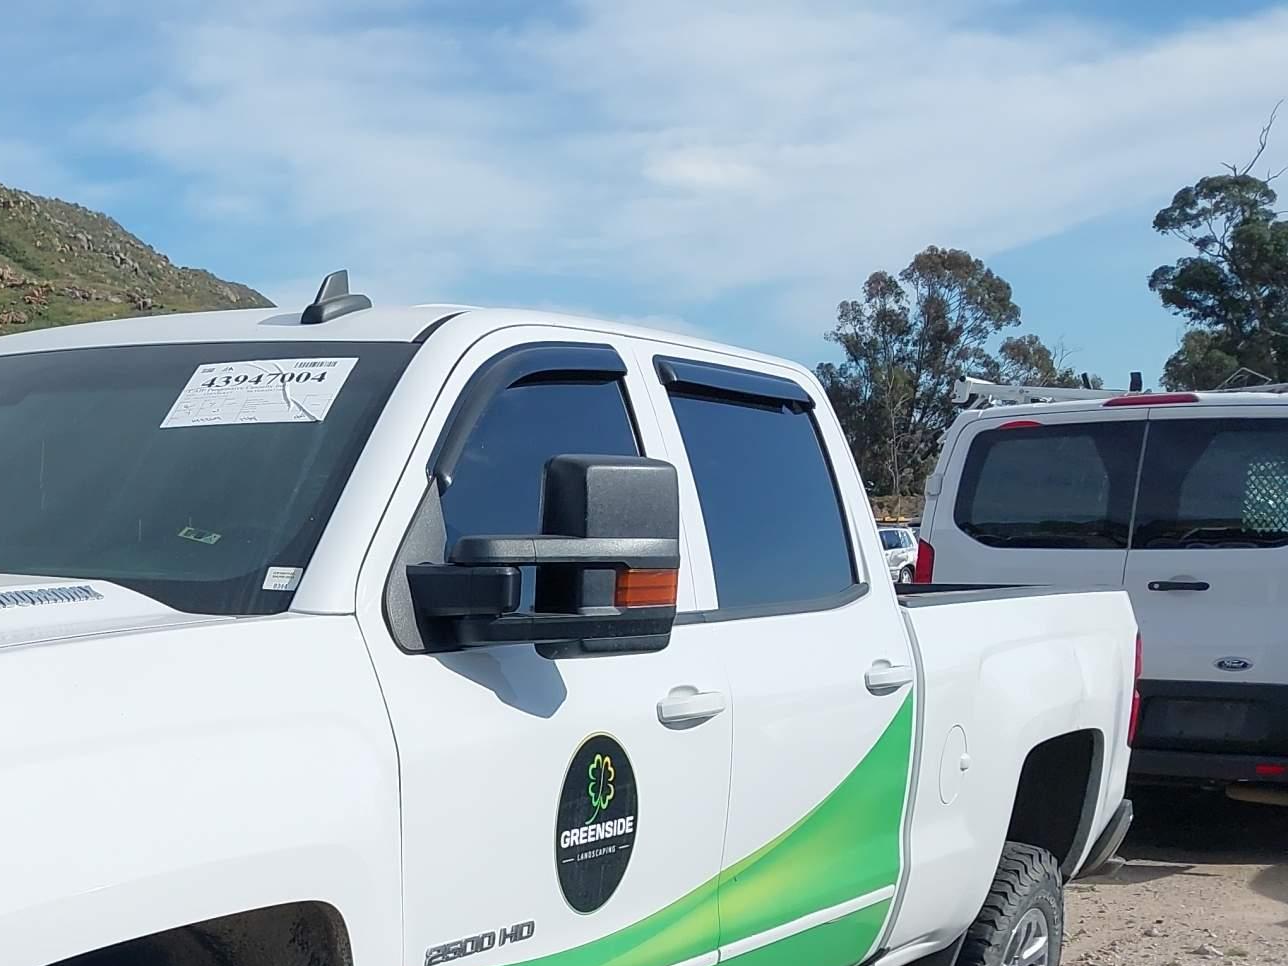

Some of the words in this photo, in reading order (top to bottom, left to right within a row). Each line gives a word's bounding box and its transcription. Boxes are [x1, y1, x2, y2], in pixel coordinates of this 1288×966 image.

[201, 370, 328, 388] 43947004
[560, 815, 634, 849] GREENSIDE
[576, 845, 616, 862] LANDSCAPING
[498, 920, 535, 947] HD
